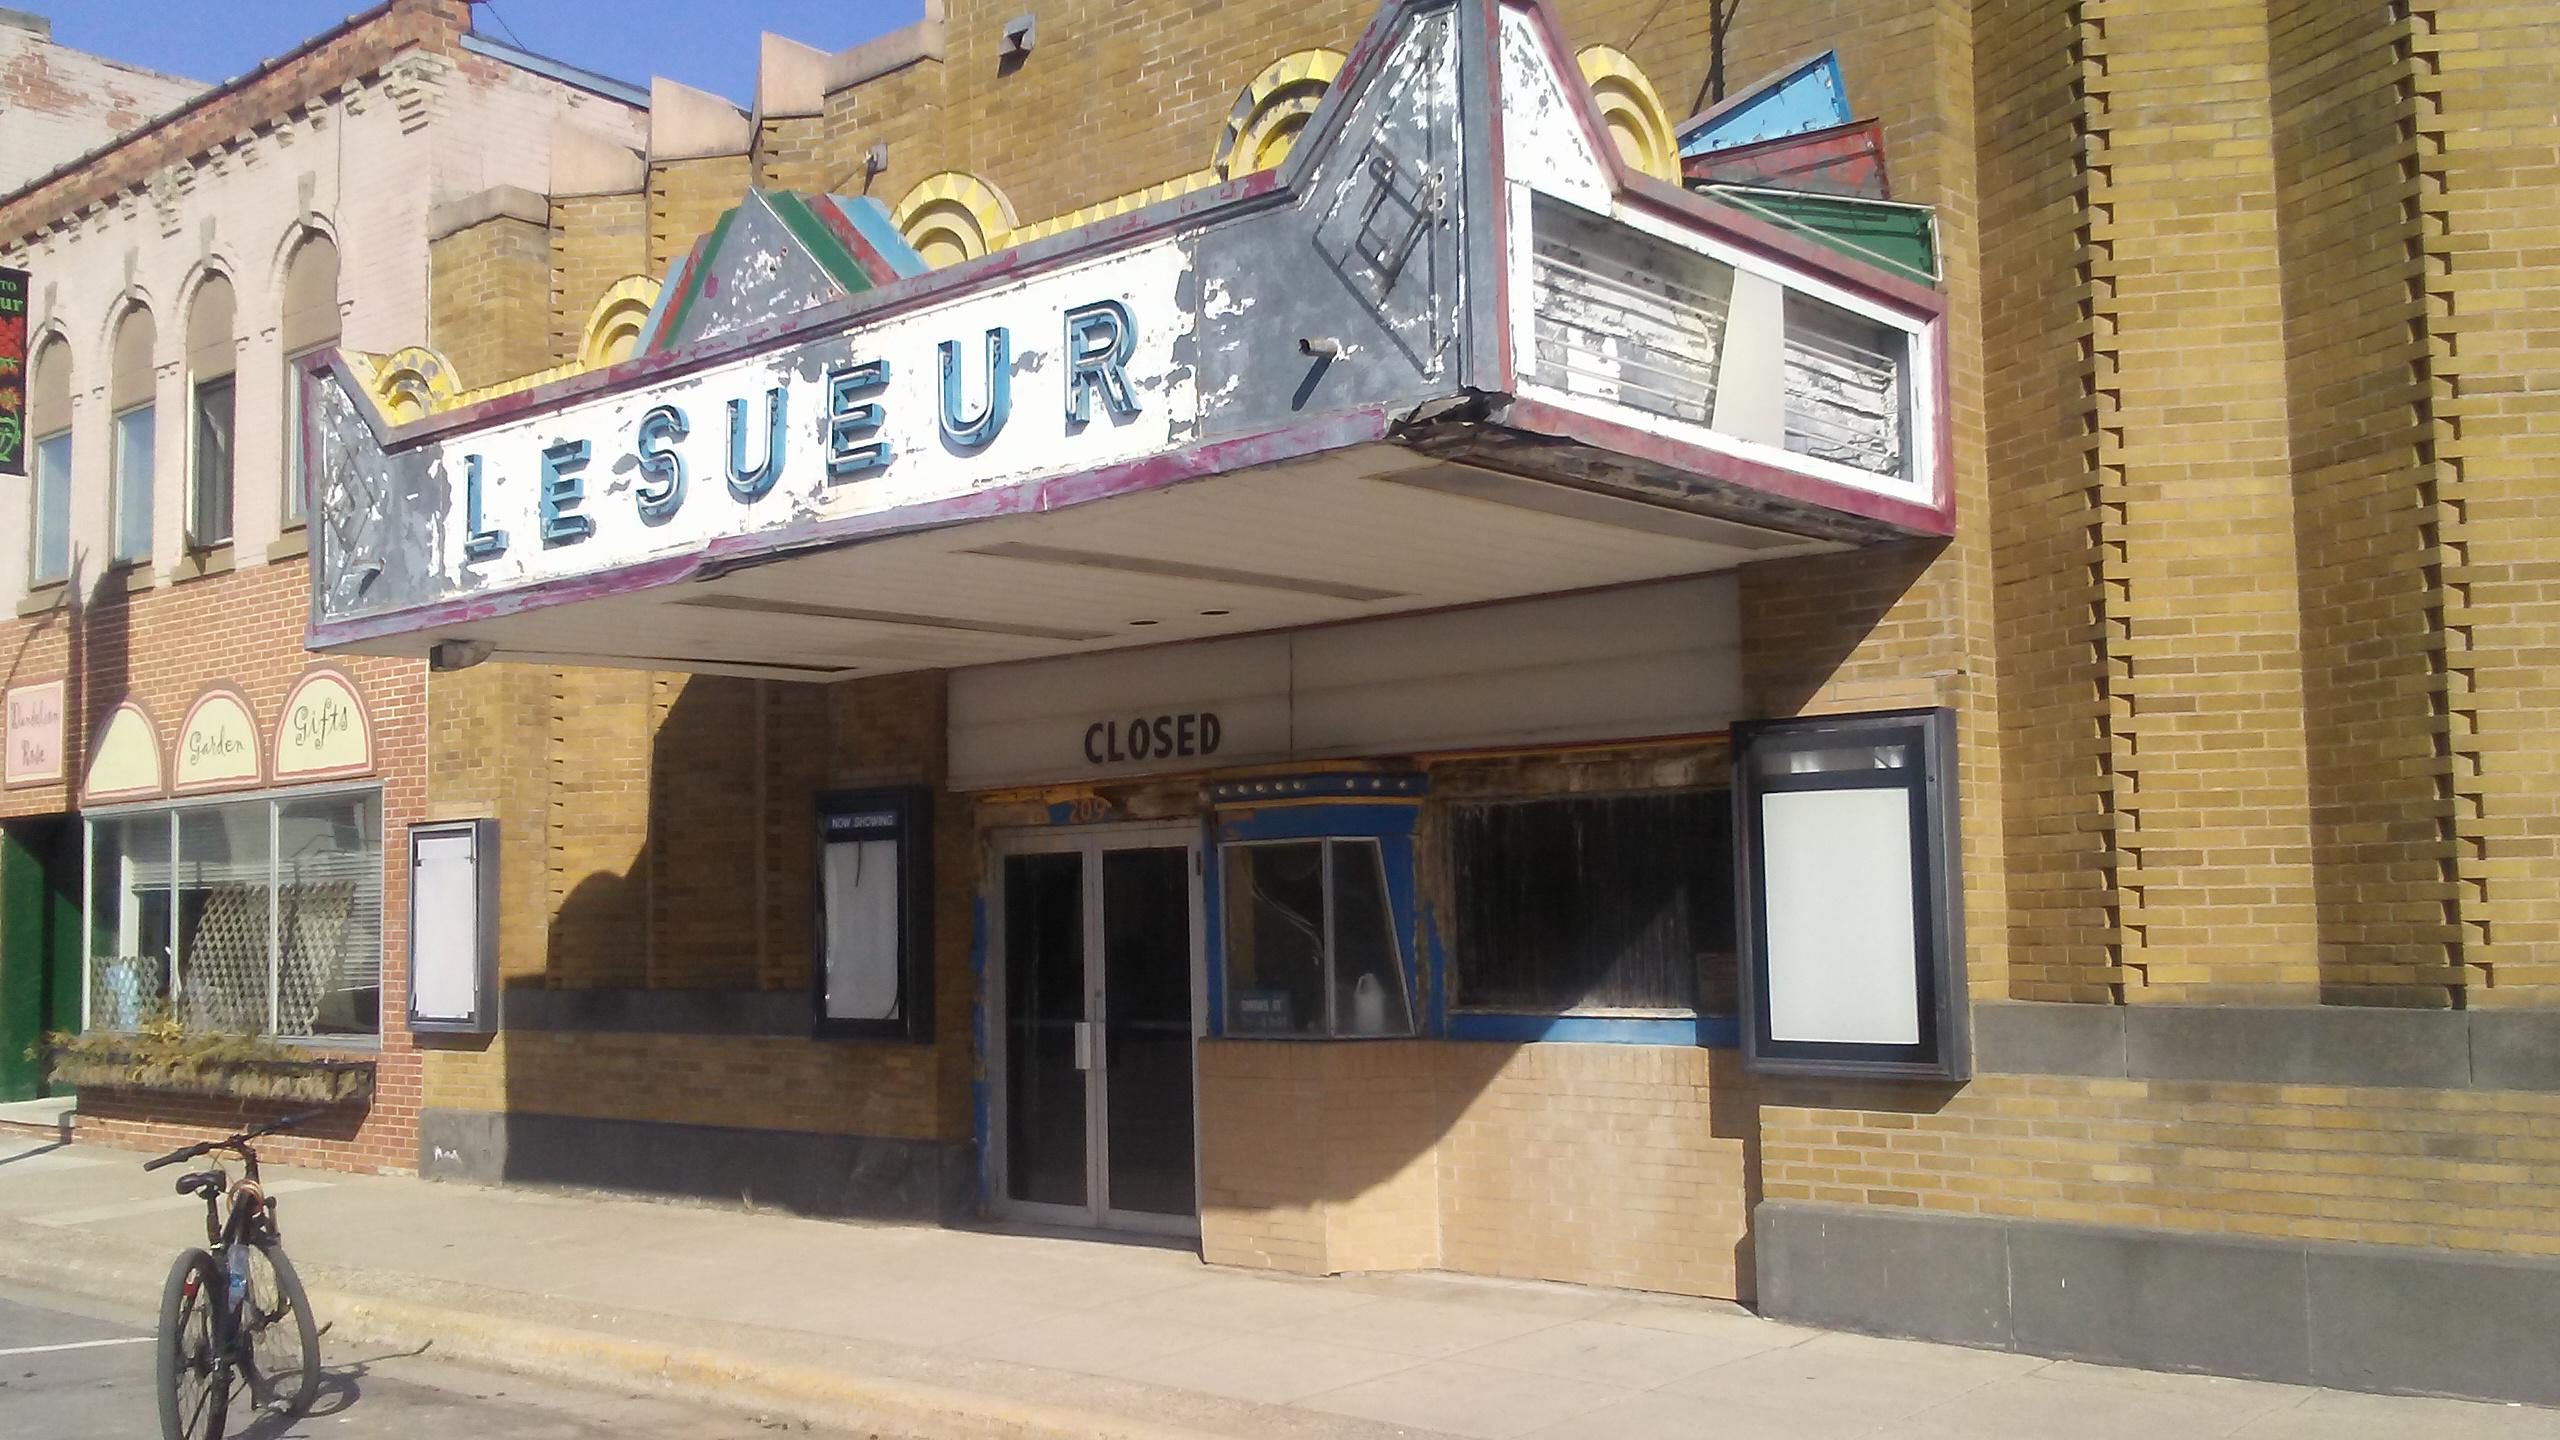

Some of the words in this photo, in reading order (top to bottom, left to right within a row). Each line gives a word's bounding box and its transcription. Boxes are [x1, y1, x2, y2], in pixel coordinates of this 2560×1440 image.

[189, 725, 245, 766] Garden
[293, 697, 348, 749] Gifts
[1084, 712, 1221, 764] CLOSED
[831, 817, 851, 830] NOW
[854, 815, 894, 828] SHOWING
